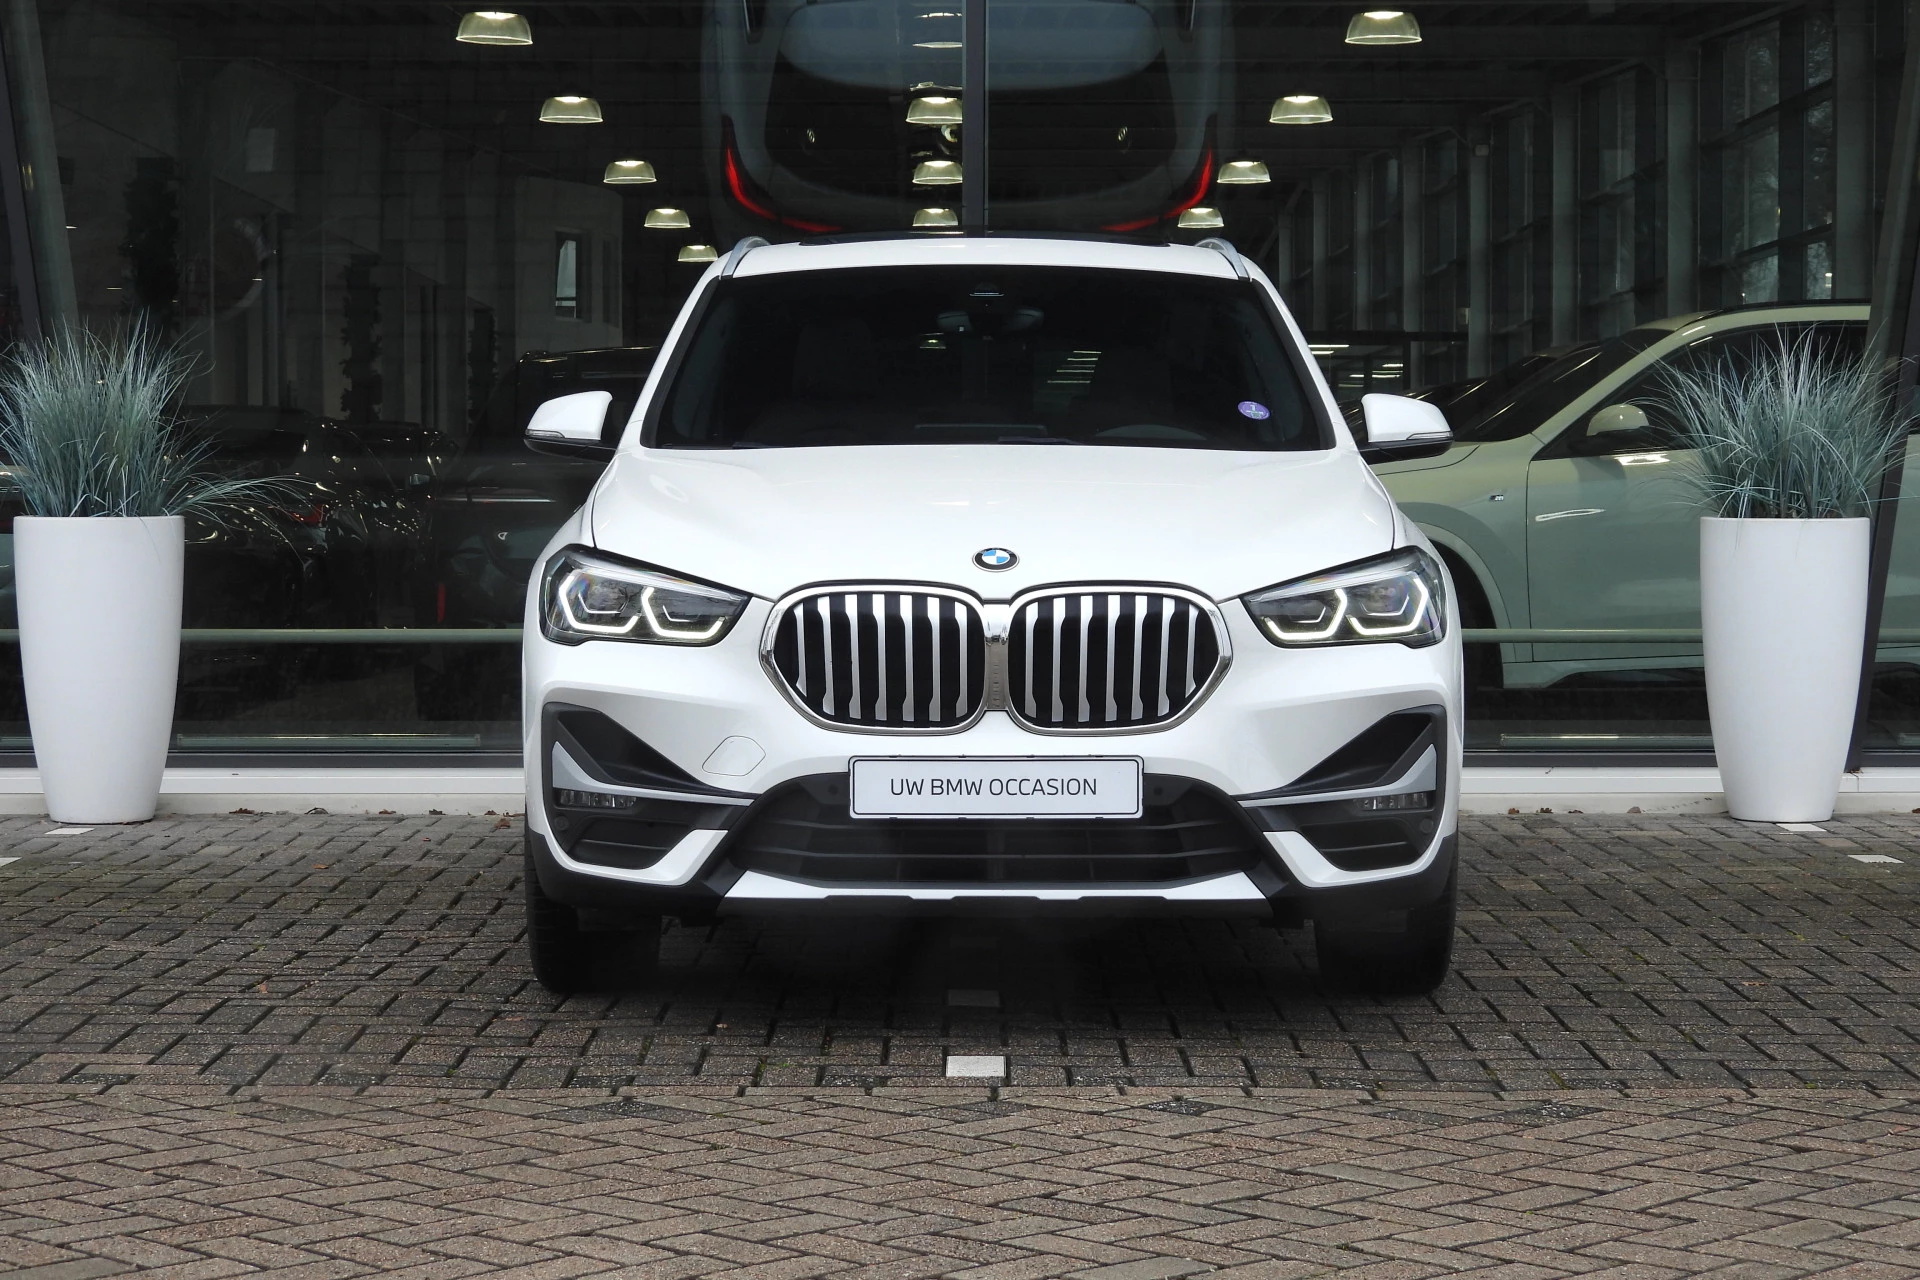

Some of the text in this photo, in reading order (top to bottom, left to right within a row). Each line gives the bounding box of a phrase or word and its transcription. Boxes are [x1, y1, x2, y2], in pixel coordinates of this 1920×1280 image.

[890, 778, 1097, 796] UW BMW OCCASION
